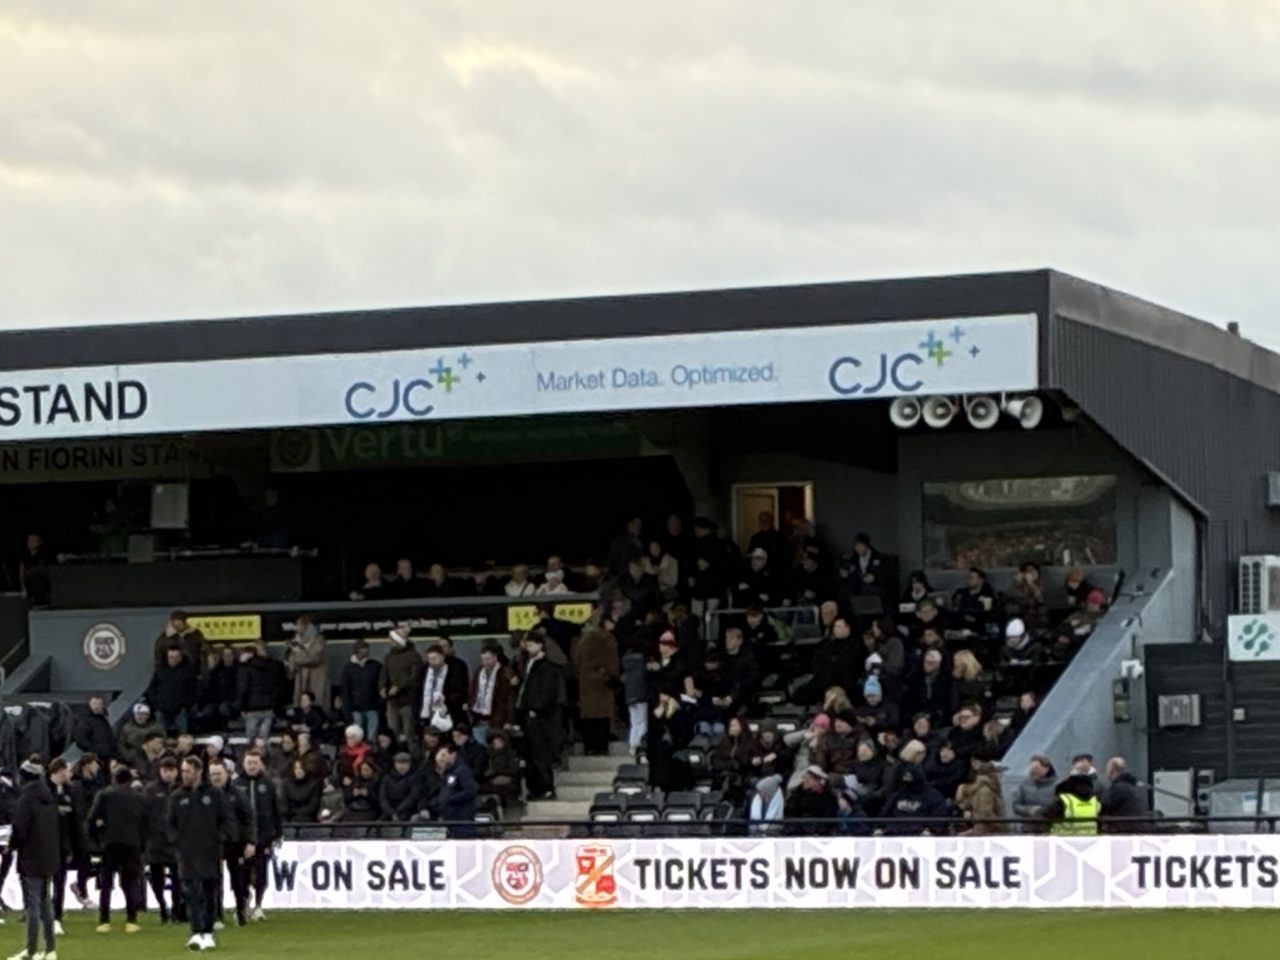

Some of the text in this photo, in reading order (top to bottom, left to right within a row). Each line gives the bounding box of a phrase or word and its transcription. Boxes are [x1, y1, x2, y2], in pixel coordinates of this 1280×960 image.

[536, 362, 780, 393] Market Data. Optimized.
[828, 353, 925, 394] CJC
[344, 379, 435, 419] CJC
[28, 446, 123, 470] FIORINI
[312, 860, 351, 890] ON
[368, 860, 444, 890] SALE
[635, 856, 1019, 889] TICKETS NOW ON SALE
[1132, 856, 1277, 887] TICKETS
